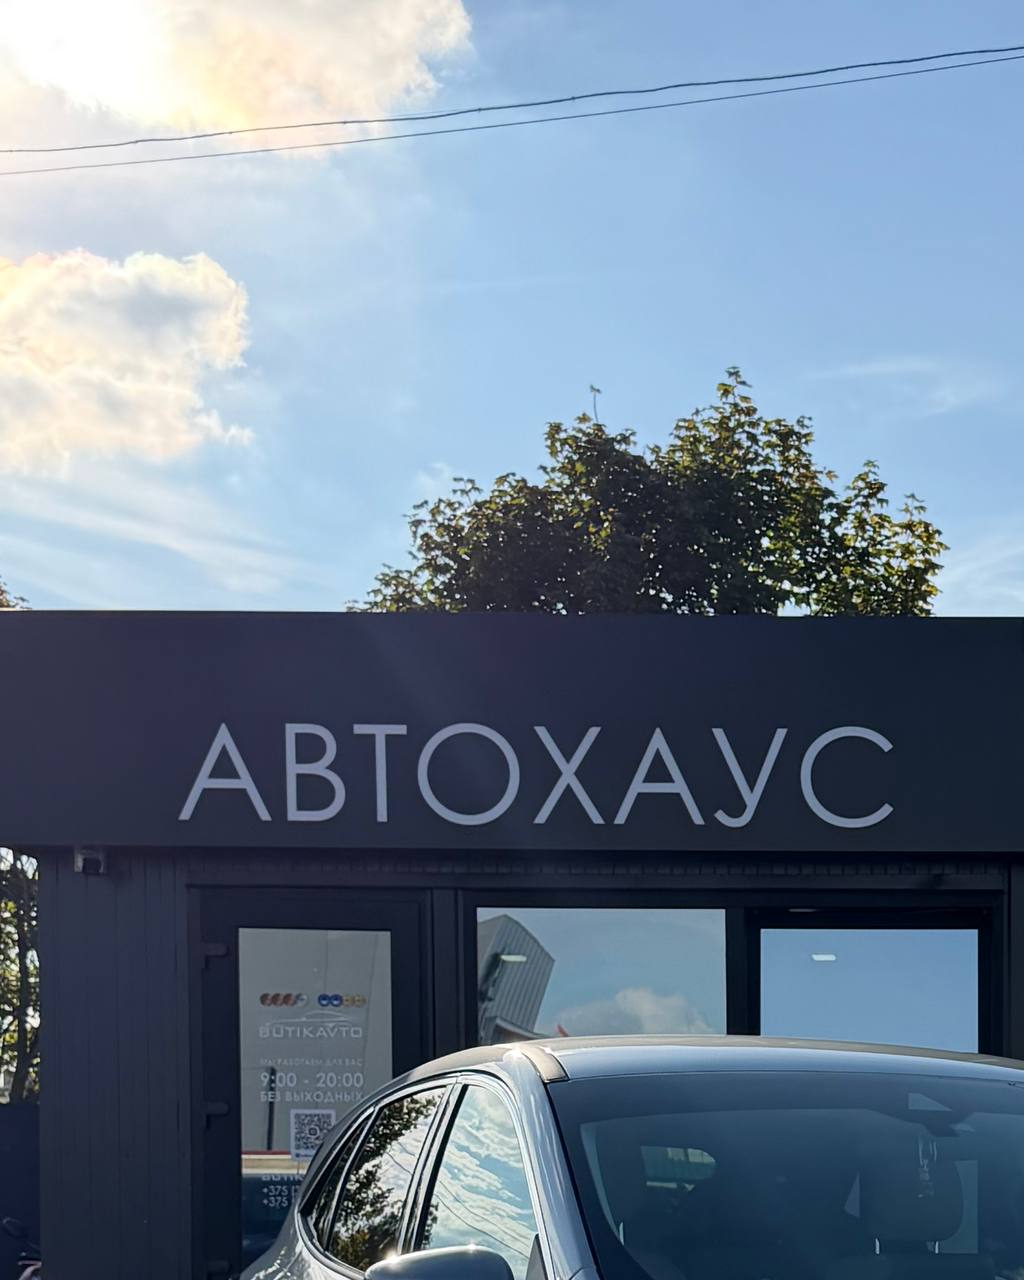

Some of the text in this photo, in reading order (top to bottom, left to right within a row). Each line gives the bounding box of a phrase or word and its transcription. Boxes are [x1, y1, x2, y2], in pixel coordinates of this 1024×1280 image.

[178, 722, 894, 828] АВТОХАУС
[258, 1024, 363, 1038] BUTIKAVTO
[260, 1072, 297, 1088] 9:00
[316, 1072, 364, 1088] 20:00
[260, 1091, 364, 1103] БЕЗ ВЫХОДНЫХ
